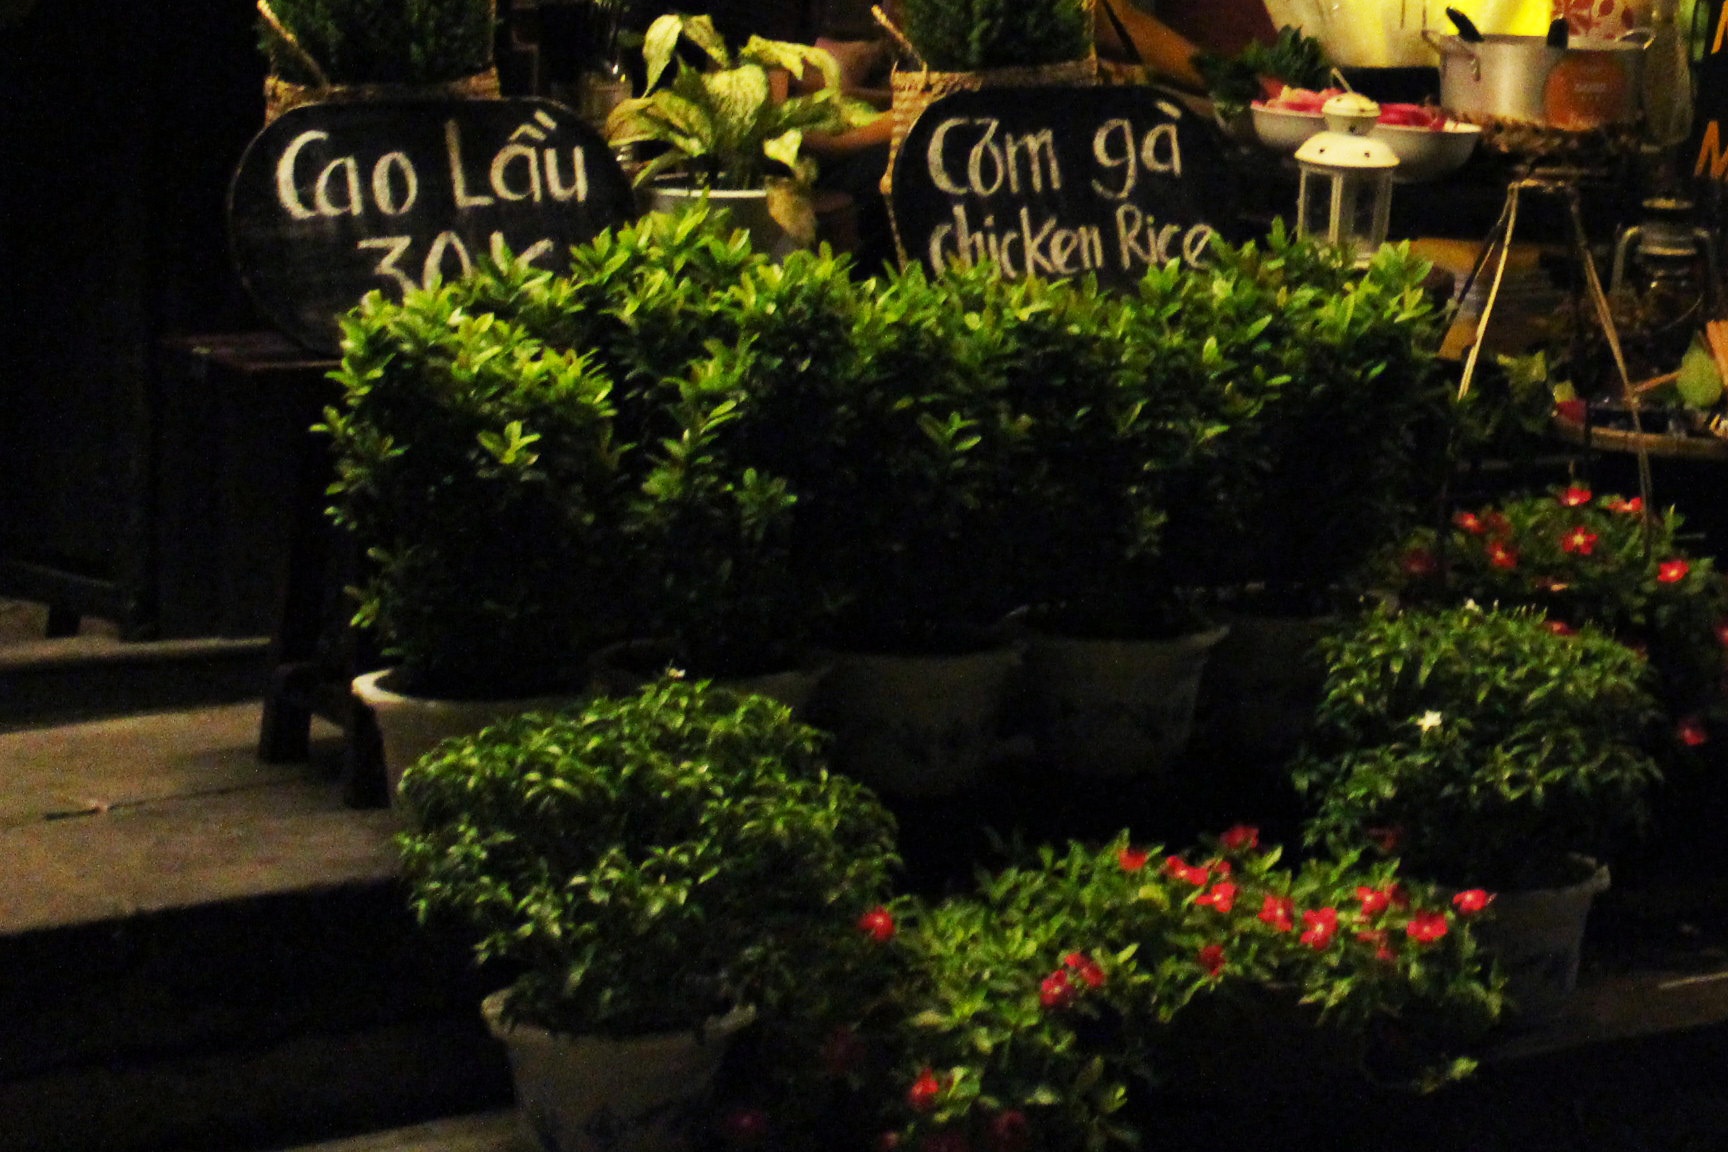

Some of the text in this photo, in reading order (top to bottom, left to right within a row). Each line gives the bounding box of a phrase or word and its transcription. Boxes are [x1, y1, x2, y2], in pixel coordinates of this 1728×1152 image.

[275, 109, 588, 220] Cao Lầu
[1091, 101, 1183, 199] gà
[929, 203, 1212, 280] chicken Rice
